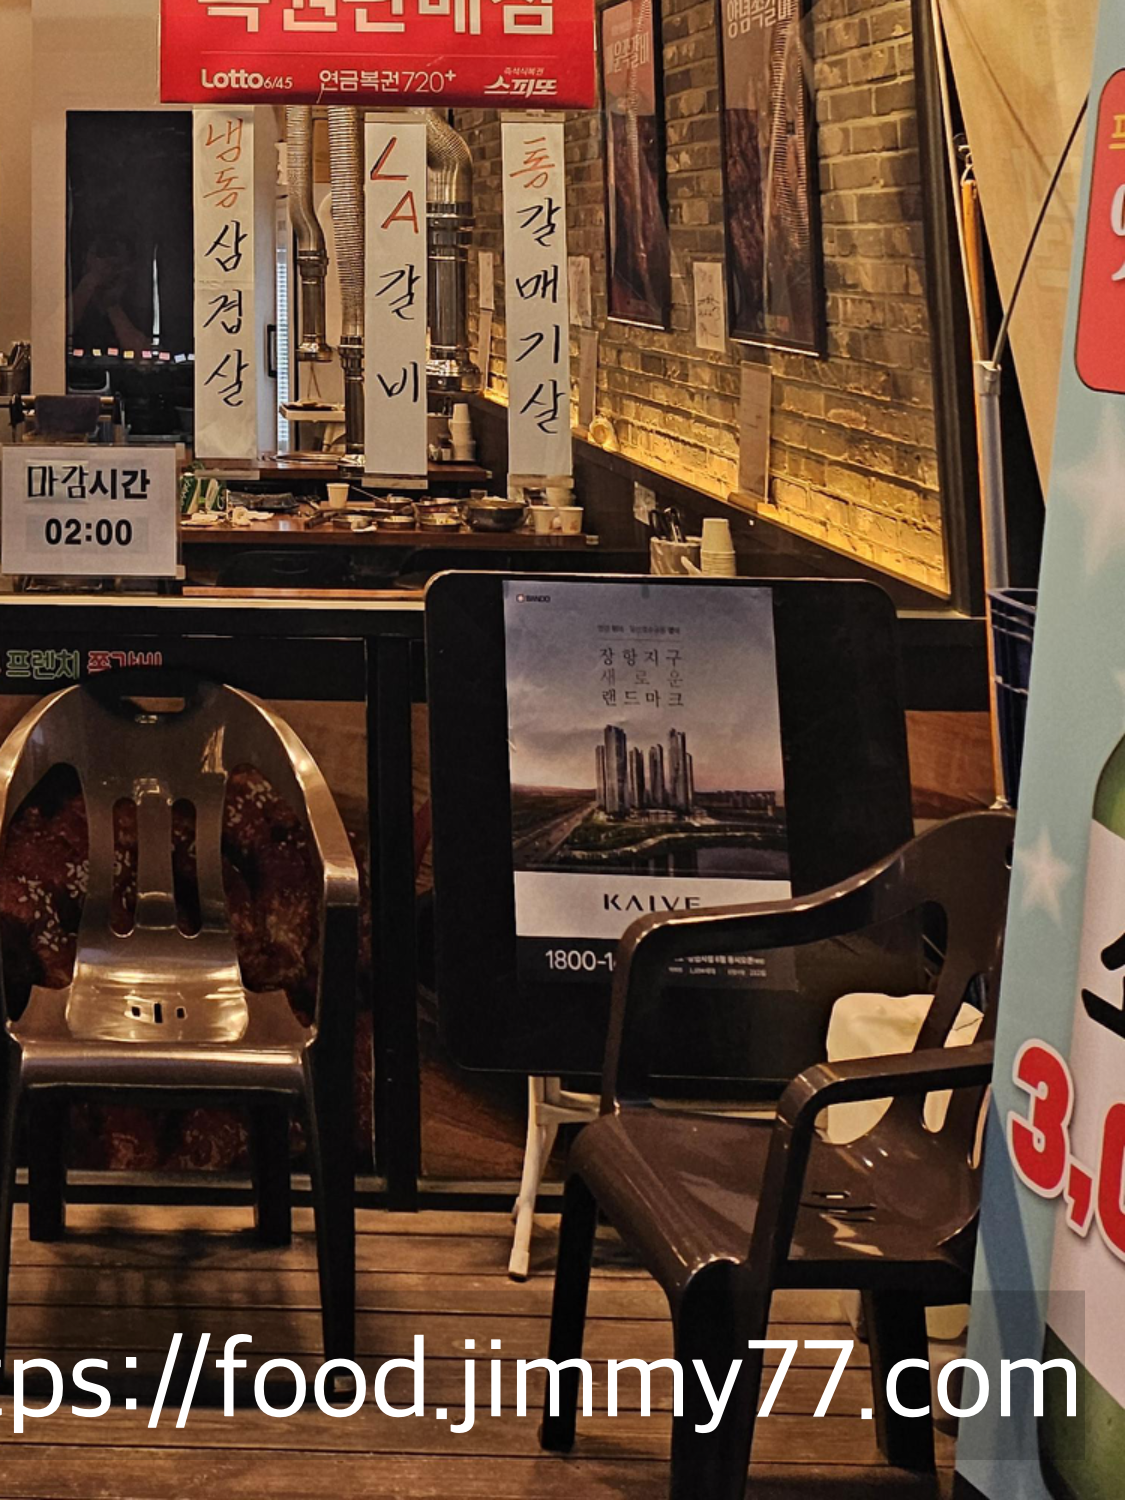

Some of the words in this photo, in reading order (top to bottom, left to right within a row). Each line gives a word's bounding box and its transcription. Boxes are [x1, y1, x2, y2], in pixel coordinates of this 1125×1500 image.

[27, 465, 151, 500] 마감시간
[45, 518, 133, 546] 02:00
[6, 649, 80, 680] 프렌치
[600, 647, 683, 666] 장항지구
[600, 668, 683, 688] 새로운
[602, 689, 684, 708] 랜드마크
[545, 949, 617, 972] 1800-1
